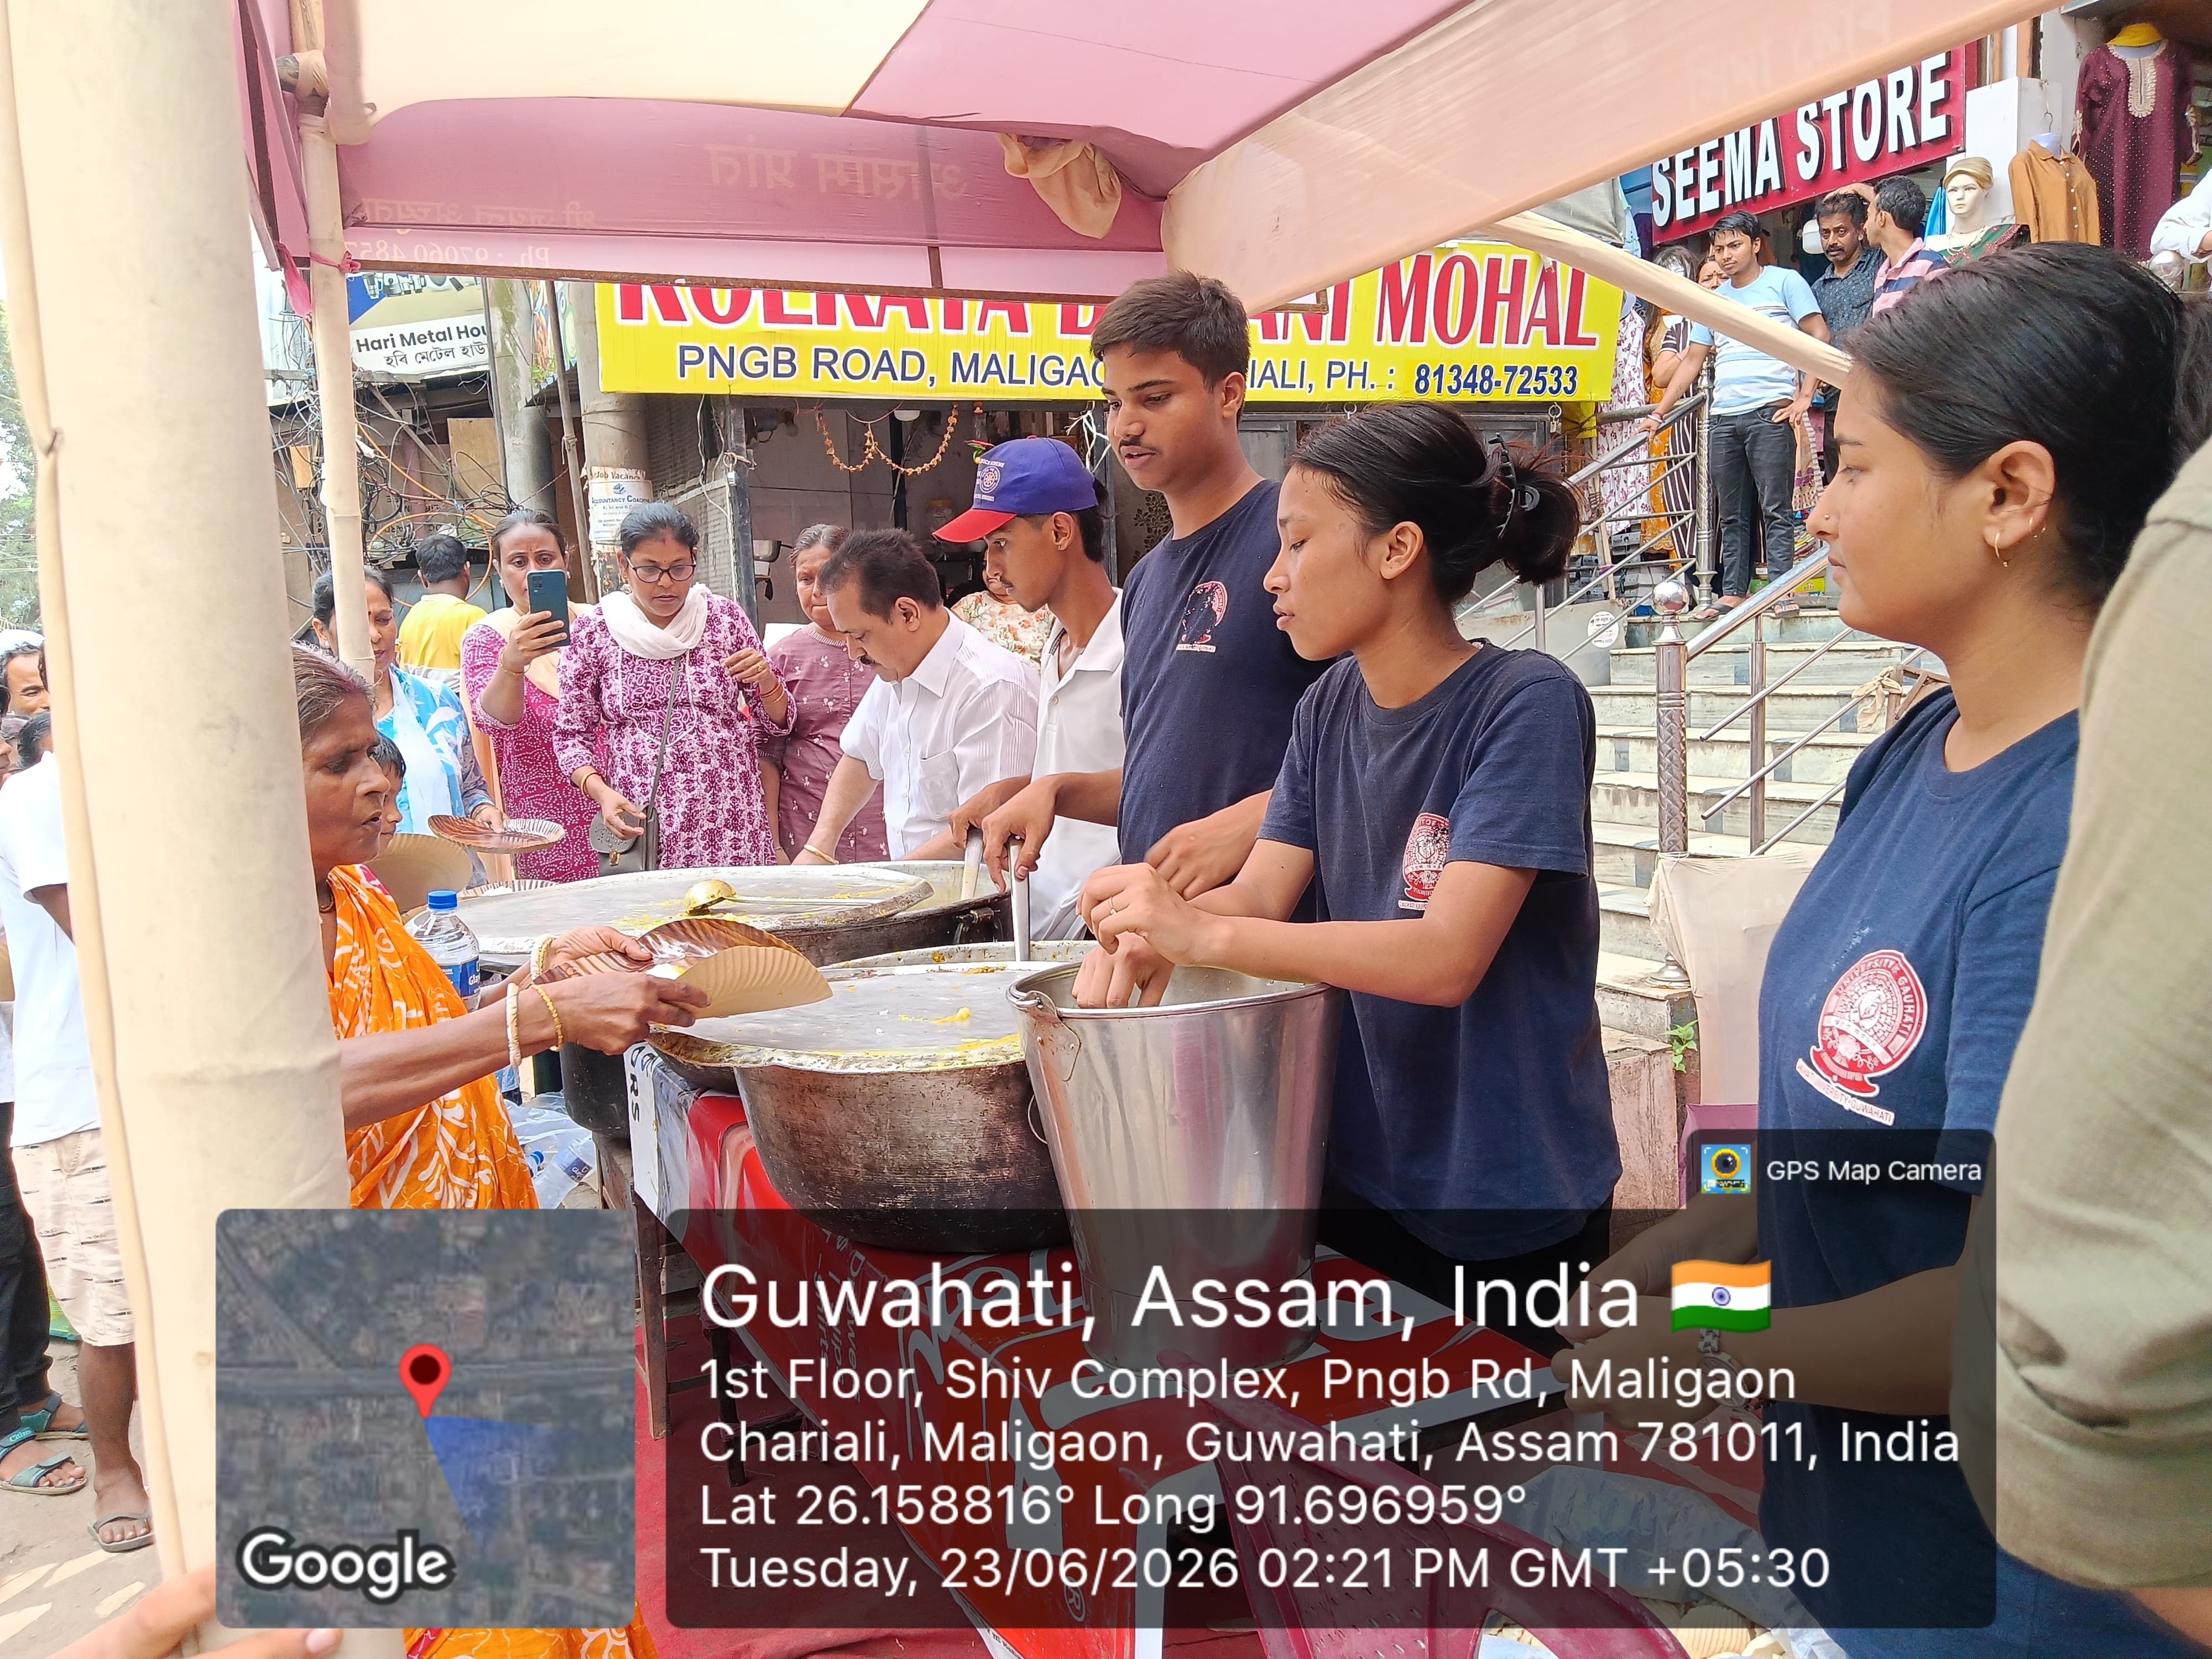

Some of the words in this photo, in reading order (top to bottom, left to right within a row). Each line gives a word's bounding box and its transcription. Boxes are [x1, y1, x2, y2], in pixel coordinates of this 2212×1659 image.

[1652, 118, 1785, 227] SEEMA
[1796, 51, 1950, 180] STORE
[1378, 254, 1598, 347] MOHAL
[356, 333, 397, 353] Hari
[399, 326, 452, 347] Metal
[456, 325, 487, 339] Hou
[415, 346, 456, 364] মেটেল
[460, 341, 488, 357] হাউ
[678, 345, 797, 379] PNGB
[813, 348, 936, 387] ROAD,
[952, 352, 1106, 387] MALIGAO
[1250, 360, 1313, 394] IALI,
[1414, 363, 1578, 397] 81348-72533
[596, 471, 609, 479] Job
